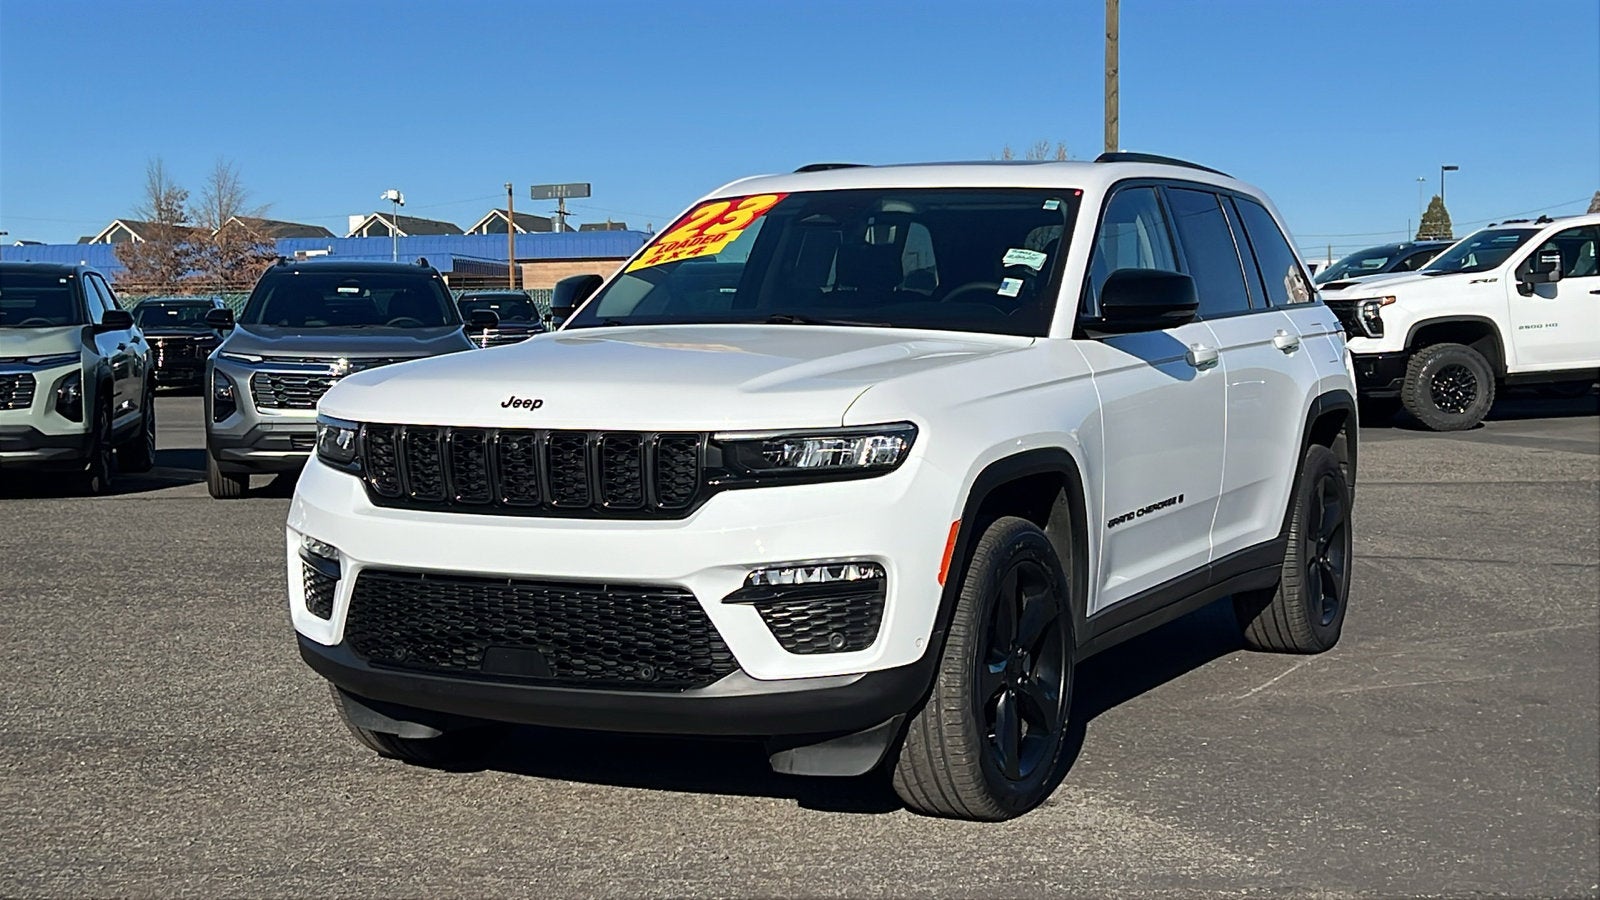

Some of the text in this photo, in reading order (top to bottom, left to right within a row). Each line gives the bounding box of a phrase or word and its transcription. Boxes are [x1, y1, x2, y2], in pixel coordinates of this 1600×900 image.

[658, 194, 779, 244] 23
[654, 232, 728, 255] LOADED
[500, 395, 544, 412] Jeep
[1107, 496, 1177, 529] GRAND CHEROKEE
